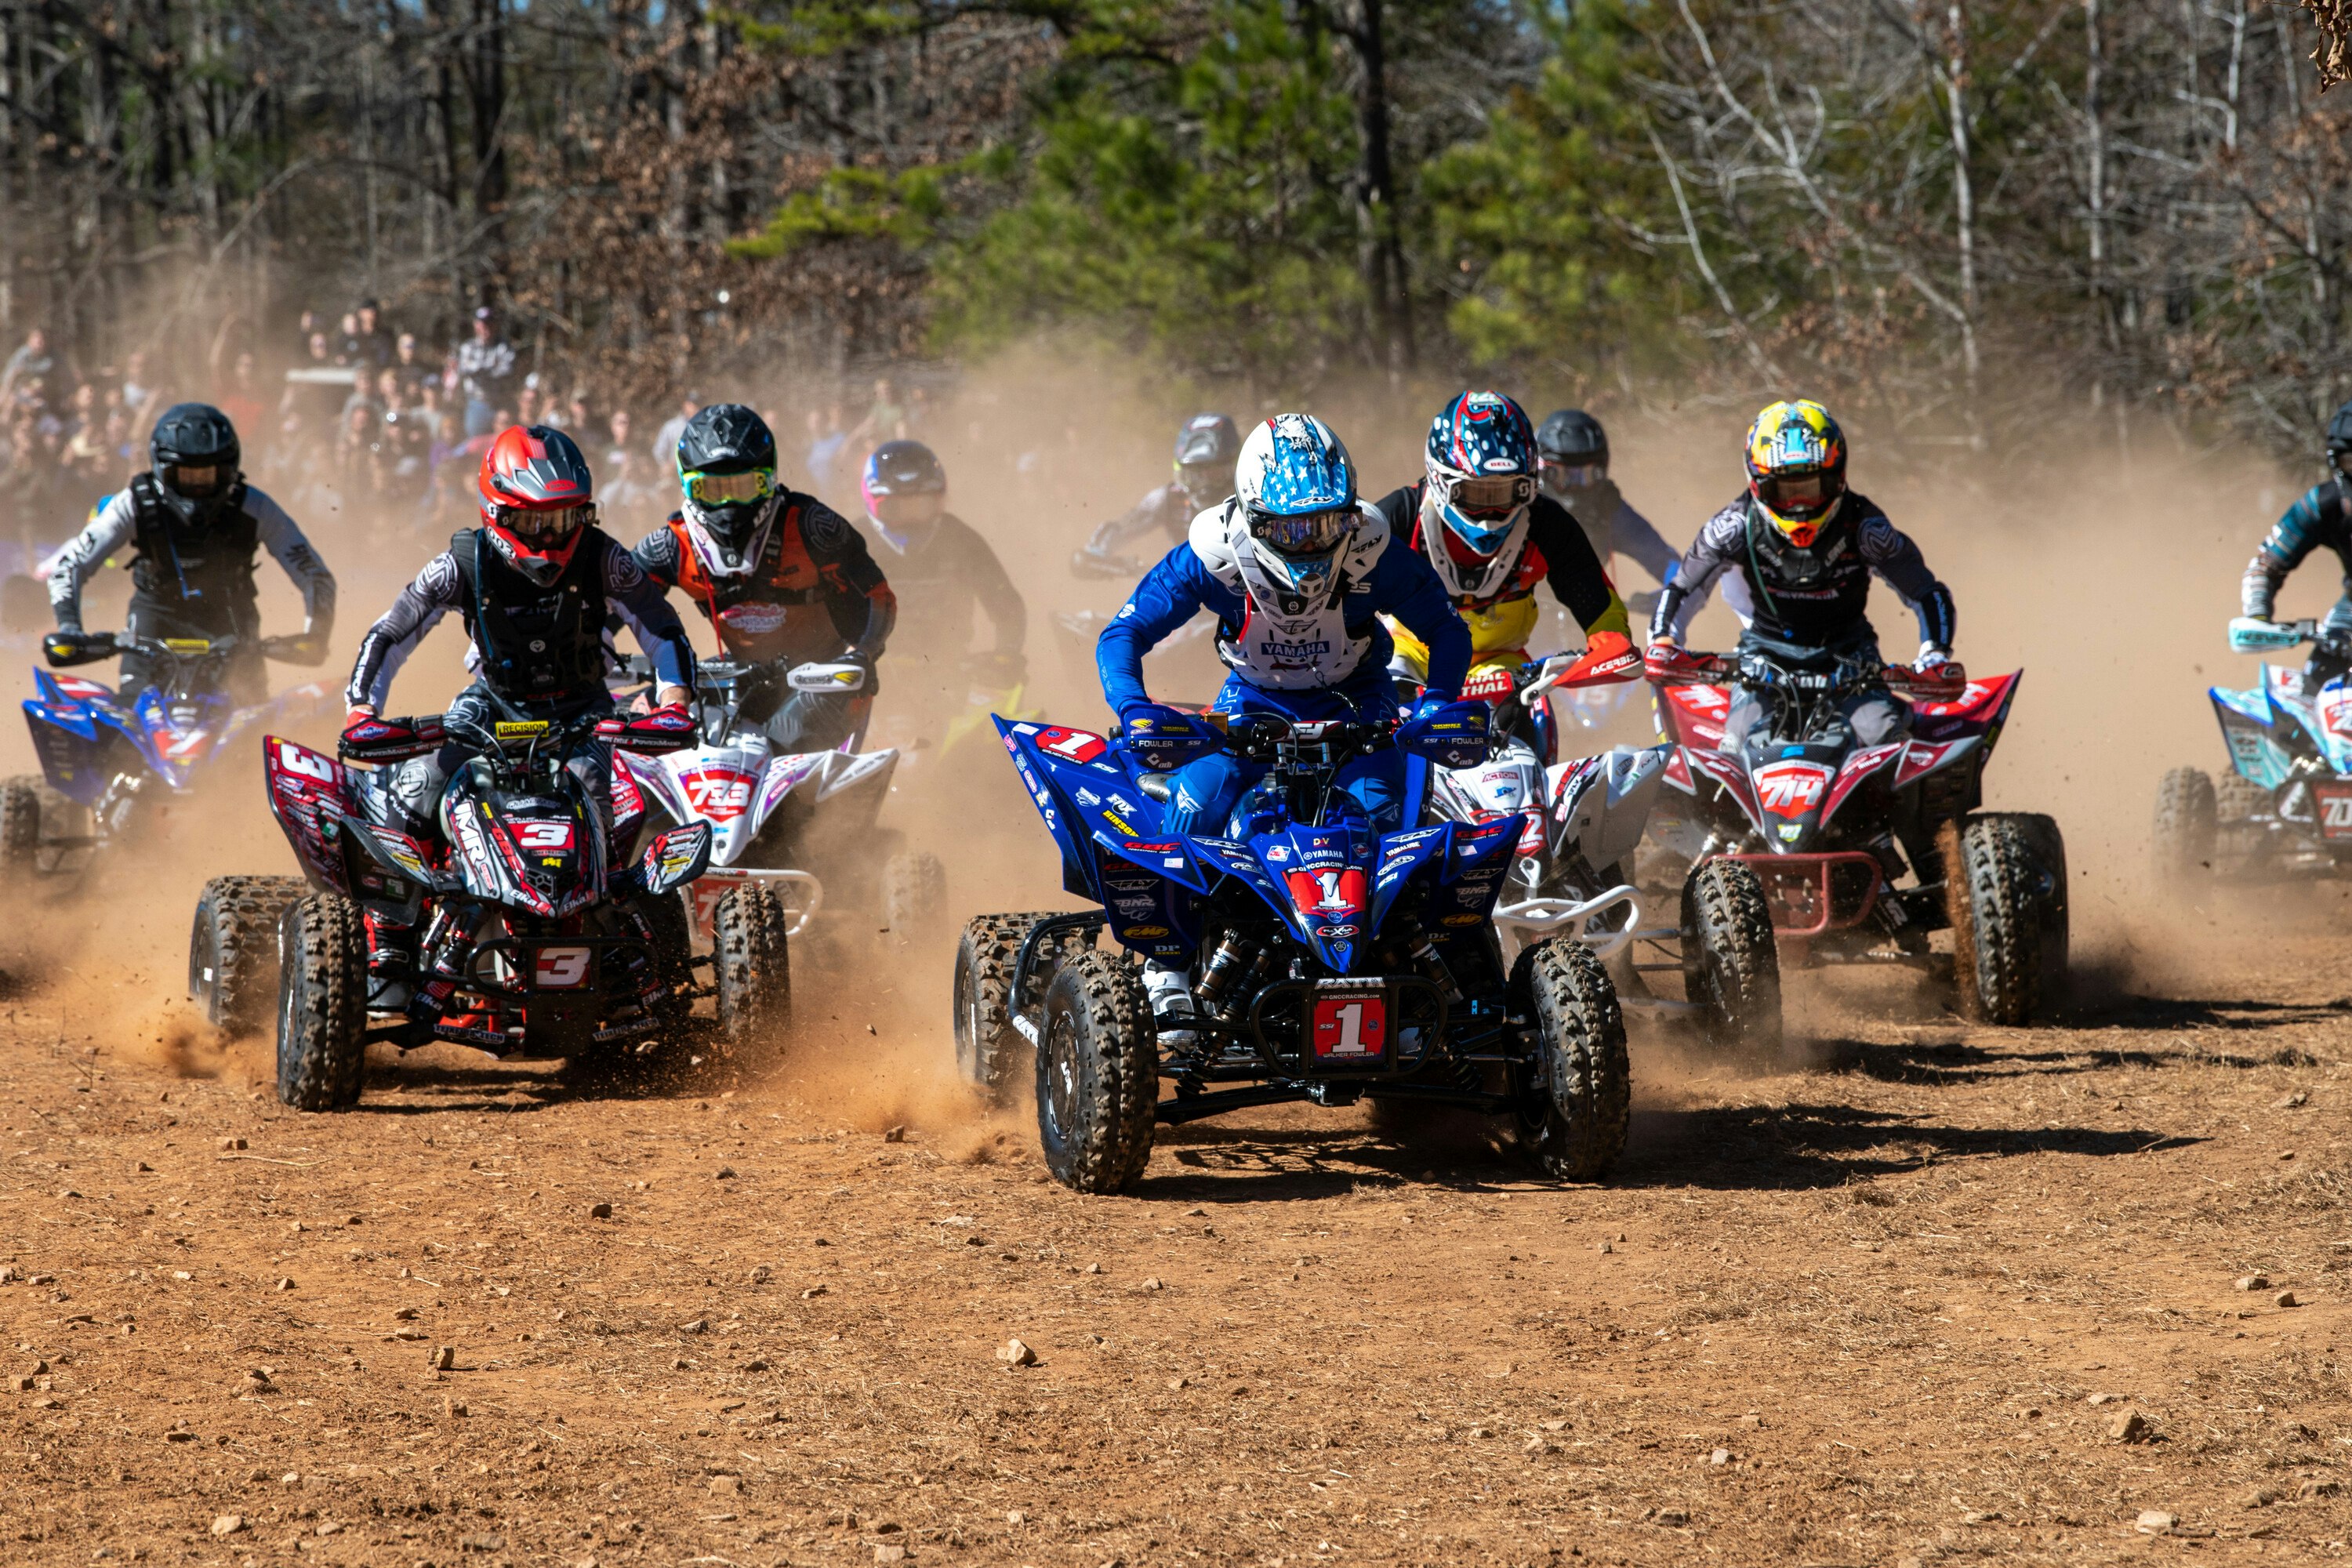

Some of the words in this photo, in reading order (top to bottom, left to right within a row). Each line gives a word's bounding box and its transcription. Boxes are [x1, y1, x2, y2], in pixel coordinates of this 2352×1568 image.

[1350, 534, 1383, 553] FLY
[1265, 642, 1326, 657] YAMAHA
[1047, 731, 1098, 756] 1
[280, 743, 334, 783] 3
[1062, 754, 1083, 765] FOWLER
[1091, 762, 1119, 773] SSI
[1483, 772, 1518, 782] ACTION
[688, 779, 750, 808] 733
[1760, 780, 1824, 808] 714
[1106, 793, 1137, 814] FOX
[520, 823, 570, 847] 3
[1385, 828, 1442, 843] FLY
[1455, 826, 1505, 838] GBC
[1123, 841, 1181, 851] GBC
[1190, 837, 1247, 849] FLY
[1385, 840, 1421, 857] YAMALUBE
[1312, 849, 1344, 858] YAMAHA
[1315, 872, 1347, 907] 1
[1377, 872, 1399, 892] SSI
[510, 889, 538, 906] Elka
[564, 897, 586, 912] Elka
[1442, 914, 1483, 925] FMF
[1124, 926, 1169, 938] FMF
[535, 947, 591, 985] 3
[1314, 976, 1386, 990] RATH
[1332, 1003, 1366, 1053] 1
